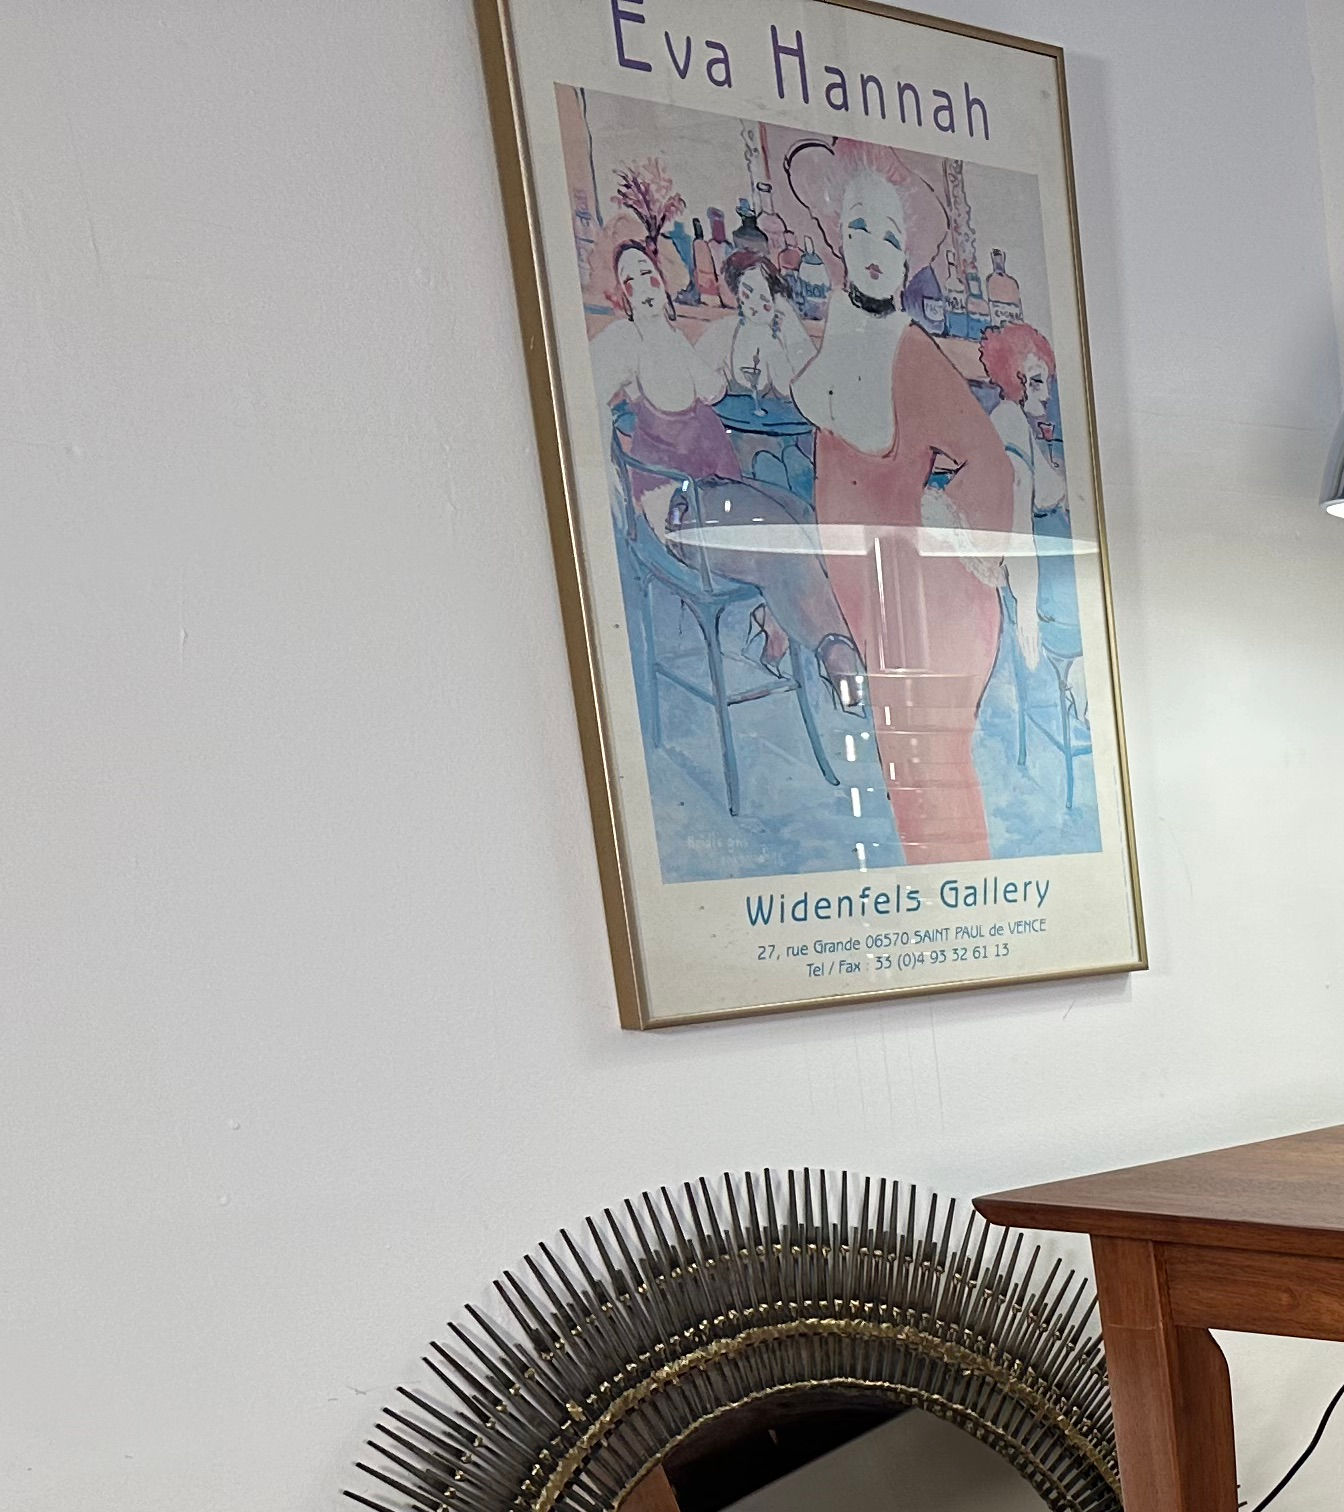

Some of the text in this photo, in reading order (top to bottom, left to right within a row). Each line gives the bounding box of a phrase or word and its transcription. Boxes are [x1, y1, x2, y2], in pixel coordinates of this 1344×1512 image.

[611, 0, 991, 142] Eva Hannah
[745, 875, 1051, 927] Widenfels Gallery
[757, 918, 1048, 961] 27, rue Grande 06570 SAINT PAUL de VENCE
[806, 963, 825, 978] Tel
[838, 958, 861, 974] Fax
[874, 955, 893, 971] 33
[897, 950, 925, 972] (0)4
[929, 949, 947, 965] 93
[951, 948, 968, 963] 32
[972, 945, 989, 960] 61
[994, 942, 1010, 958] 13
